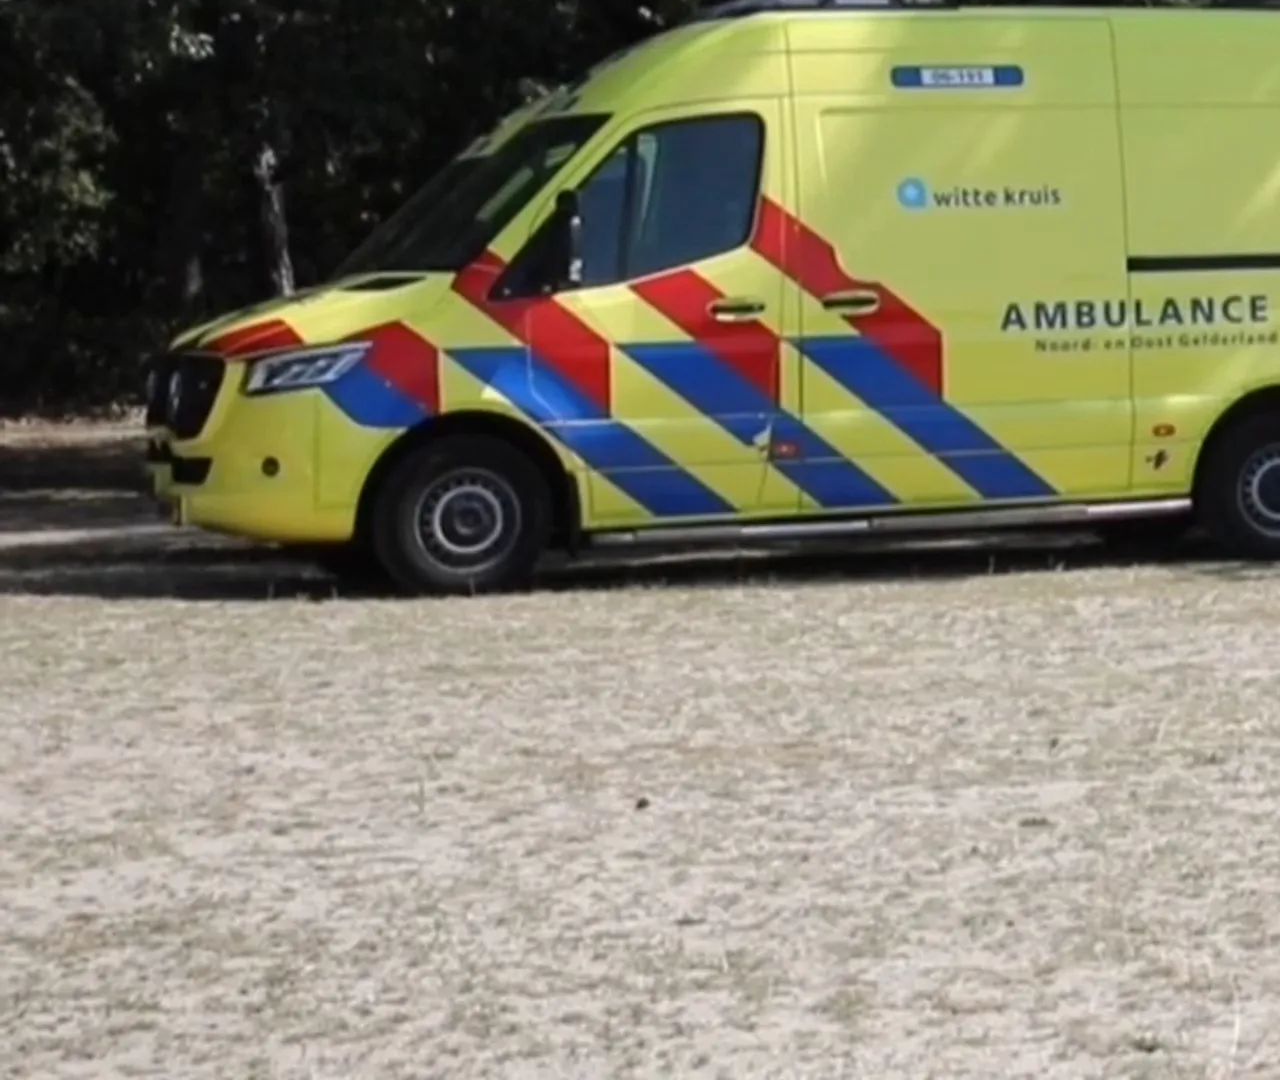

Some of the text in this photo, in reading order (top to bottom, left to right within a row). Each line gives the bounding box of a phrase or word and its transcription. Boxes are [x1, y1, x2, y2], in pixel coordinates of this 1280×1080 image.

[933, 183, 1061, 207] witte kruis
[1001, 294, 1269, 331] AMBULANCE
[1103, 339, 1126, 350] en
[1178, 330, 1279, 347] Gelderland
